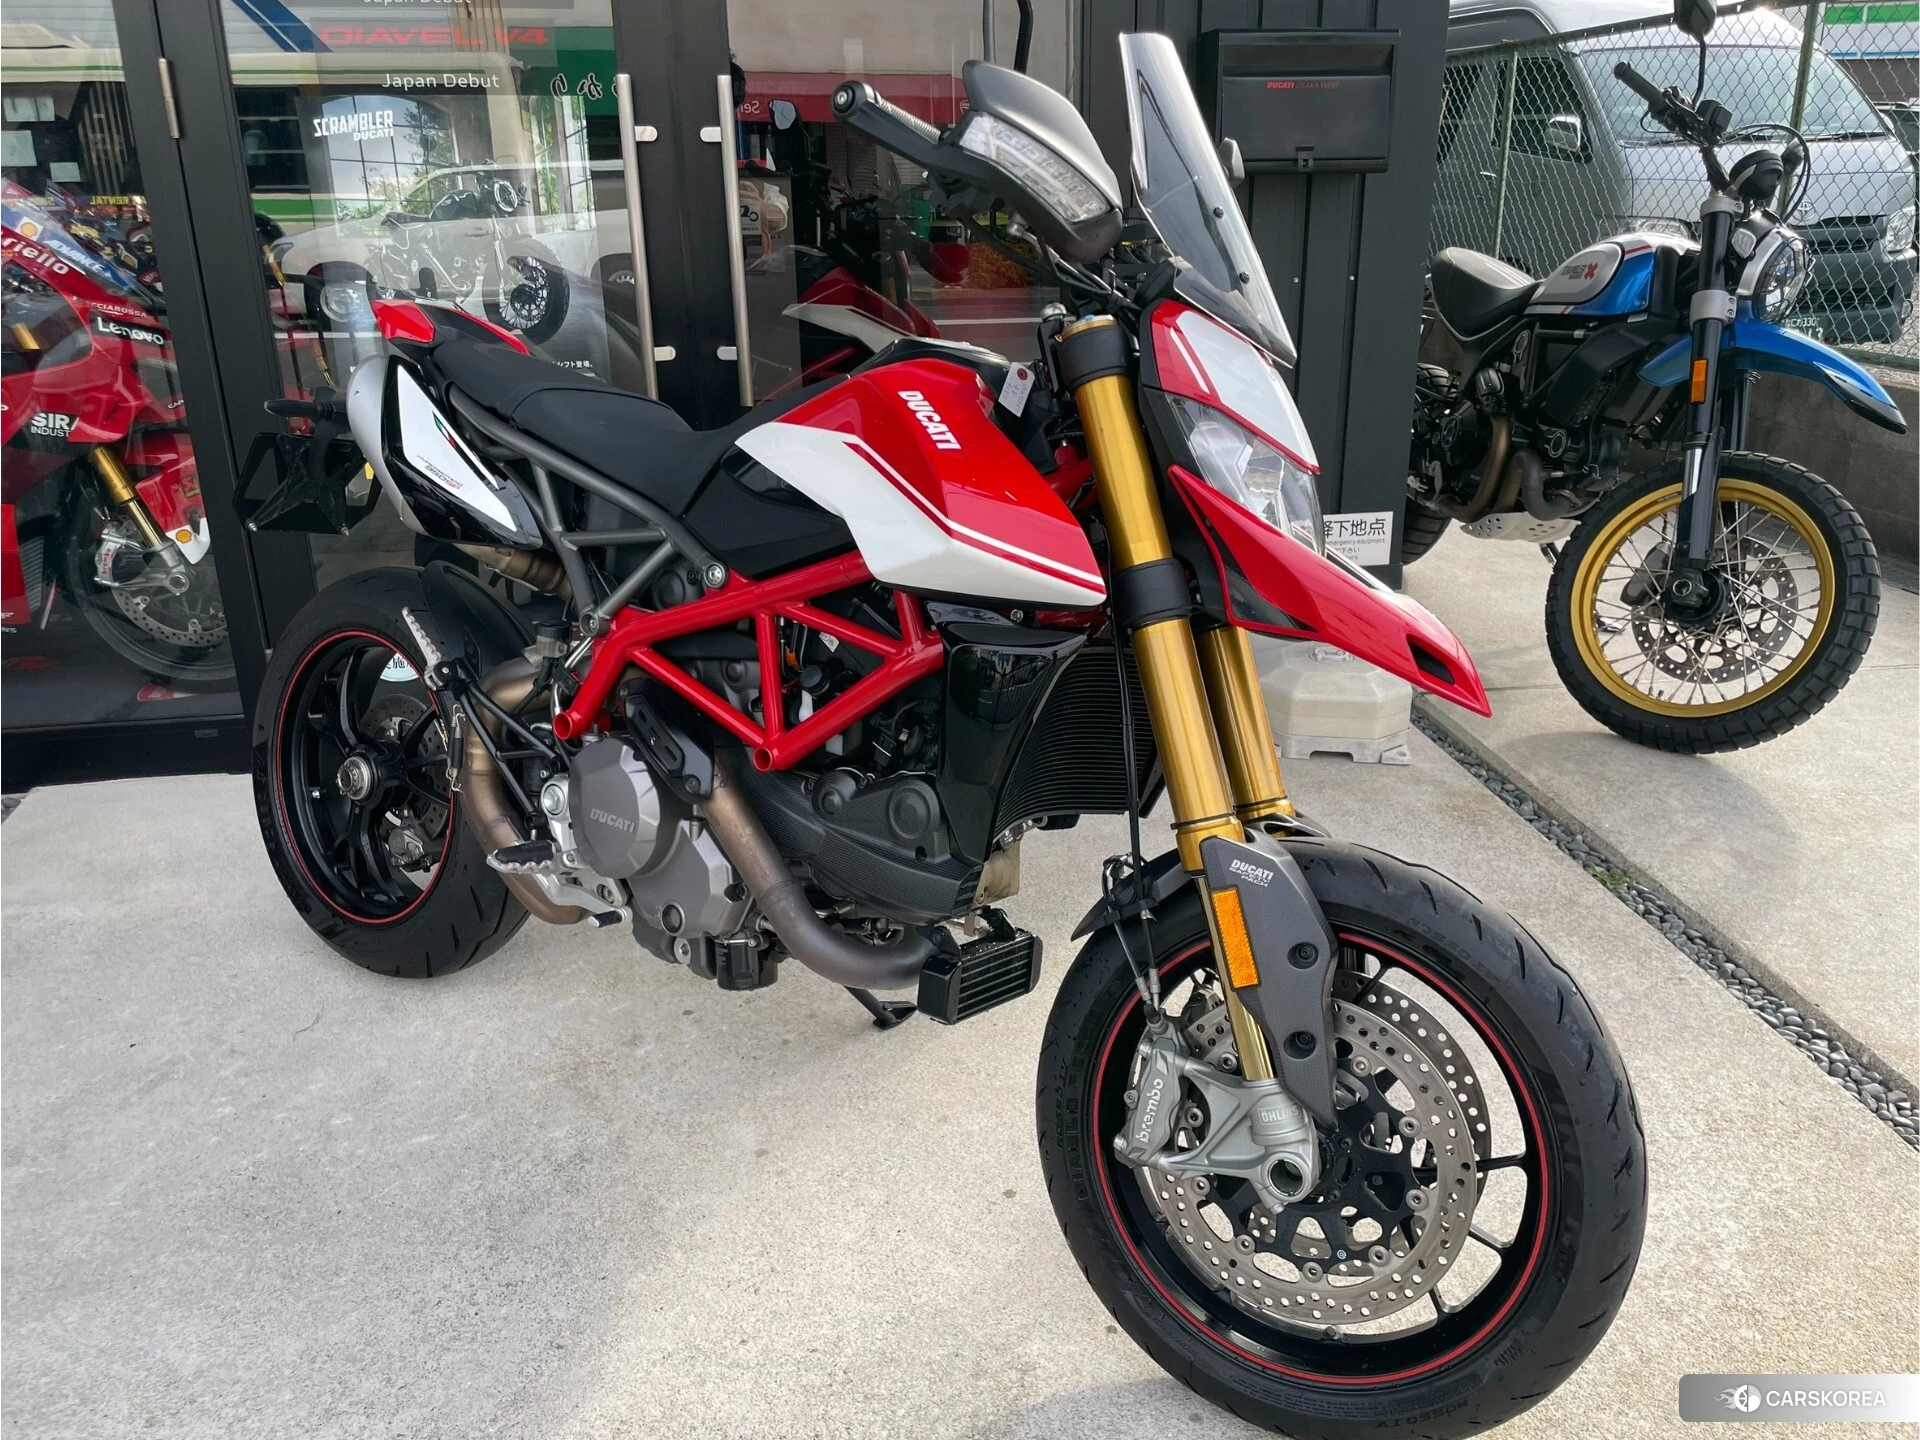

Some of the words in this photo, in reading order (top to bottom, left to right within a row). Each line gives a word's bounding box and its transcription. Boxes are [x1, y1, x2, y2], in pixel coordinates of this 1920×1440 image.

[320, 27, 484, 45] DIAVEL
[494, 27, 548, 45] V4
[382, 74, 437, 91] Japan
[443, 73, 500, 88] Debut
[1267, 81, 1294, 89] DUCATI
[313, 110, 393, 137] SCRAMBLER
[353, 128, 394, 141] DUCATI
[43, 239, 106, 273] ADVANCE
[97, 316, 165, 345] Lenovo
[897, 390, 962, 450] DUCATI
[589, 808, 637, 833] DUCATI
[1231, 859, 1274, 880] DUCATI
[1135, 1078, 1165, 1144] brembo
